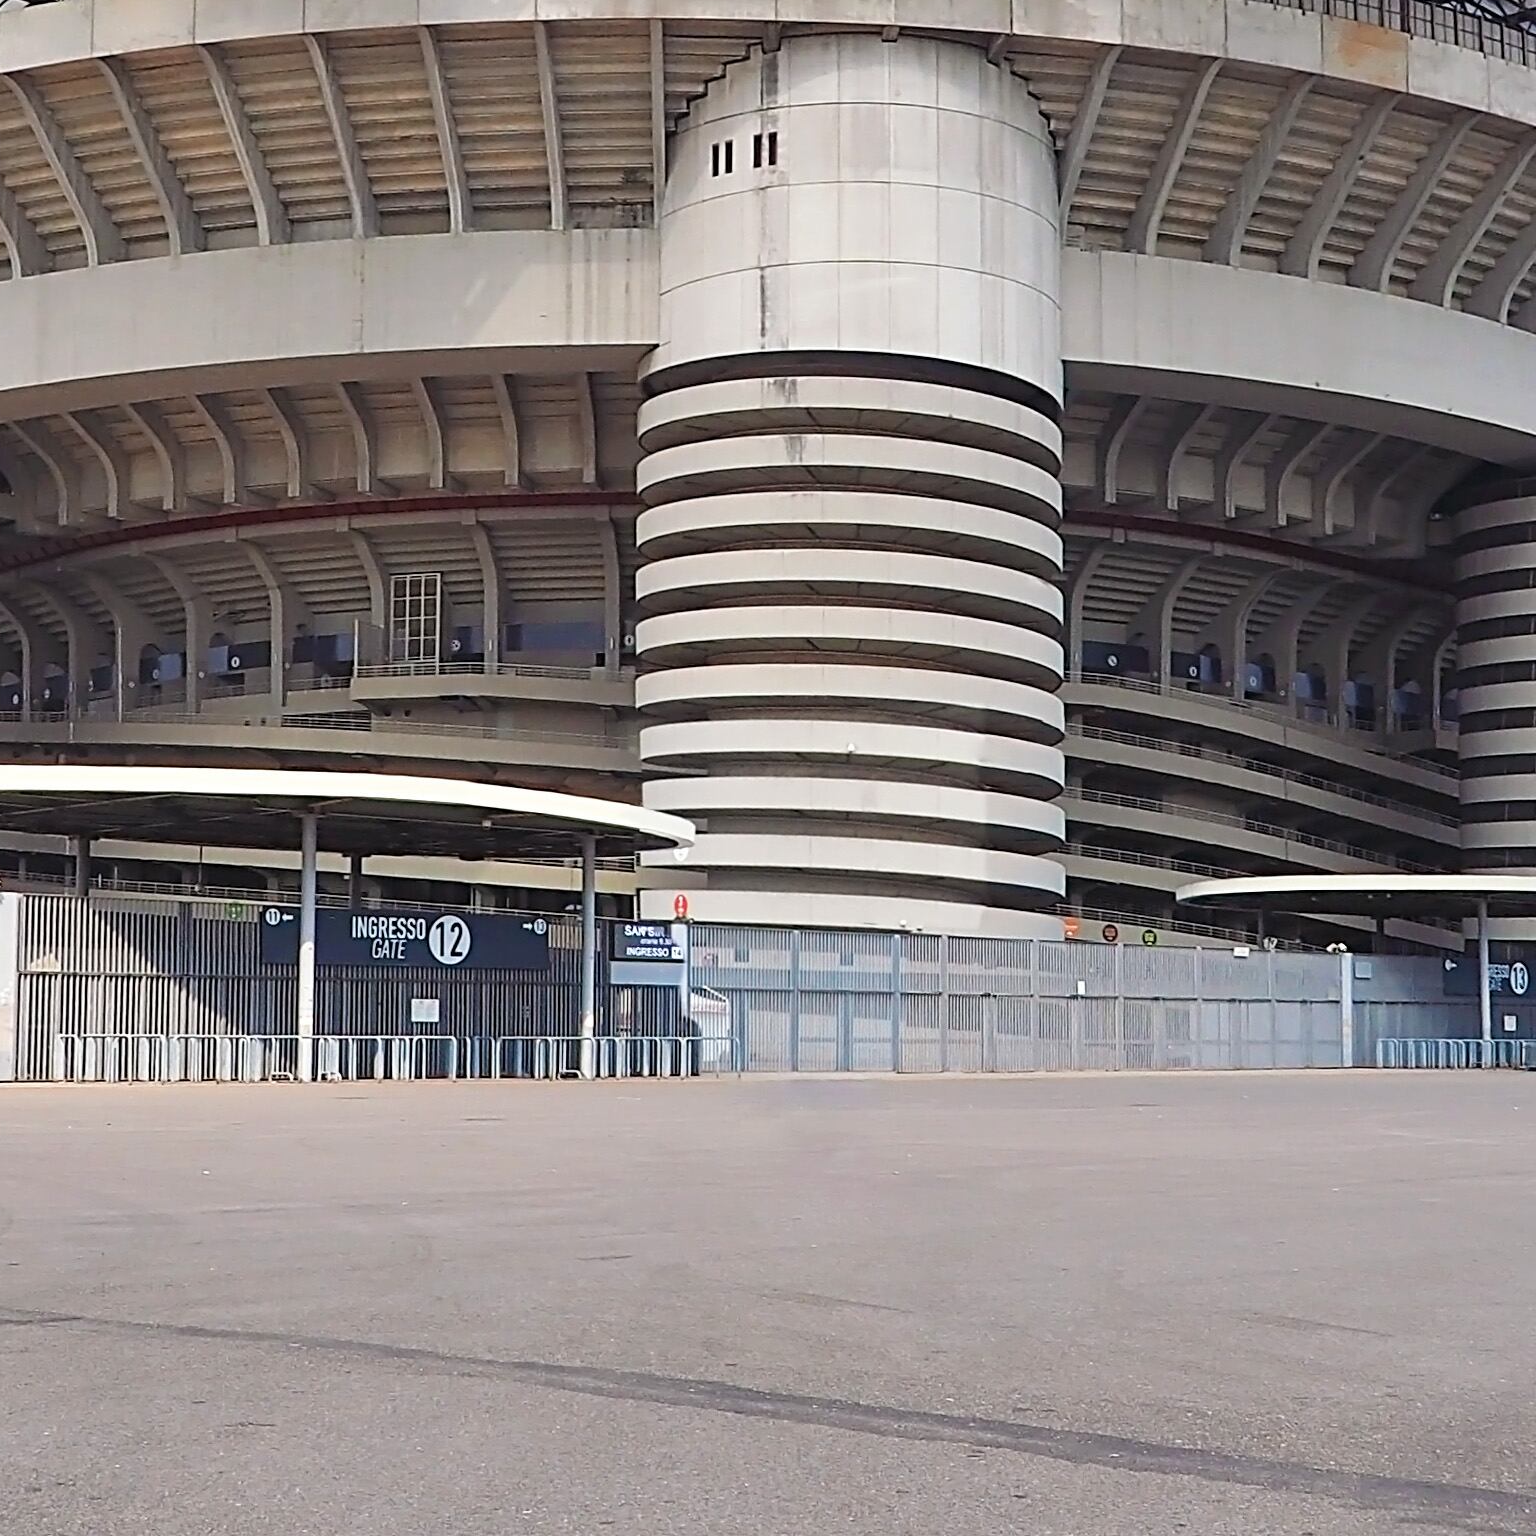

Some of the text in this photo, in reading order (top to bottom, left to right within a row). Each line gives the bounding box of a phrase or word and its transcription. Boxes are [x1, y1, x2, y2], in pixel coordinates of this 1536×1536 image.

[351, 916, 427, 940] INGRESSO
[435, 921, 463, 957] 12
[371, 938, 407, 959] GATE
[626, 946, 670, 957] INGRESSO
[1513, 967, 1526, 990] 13
